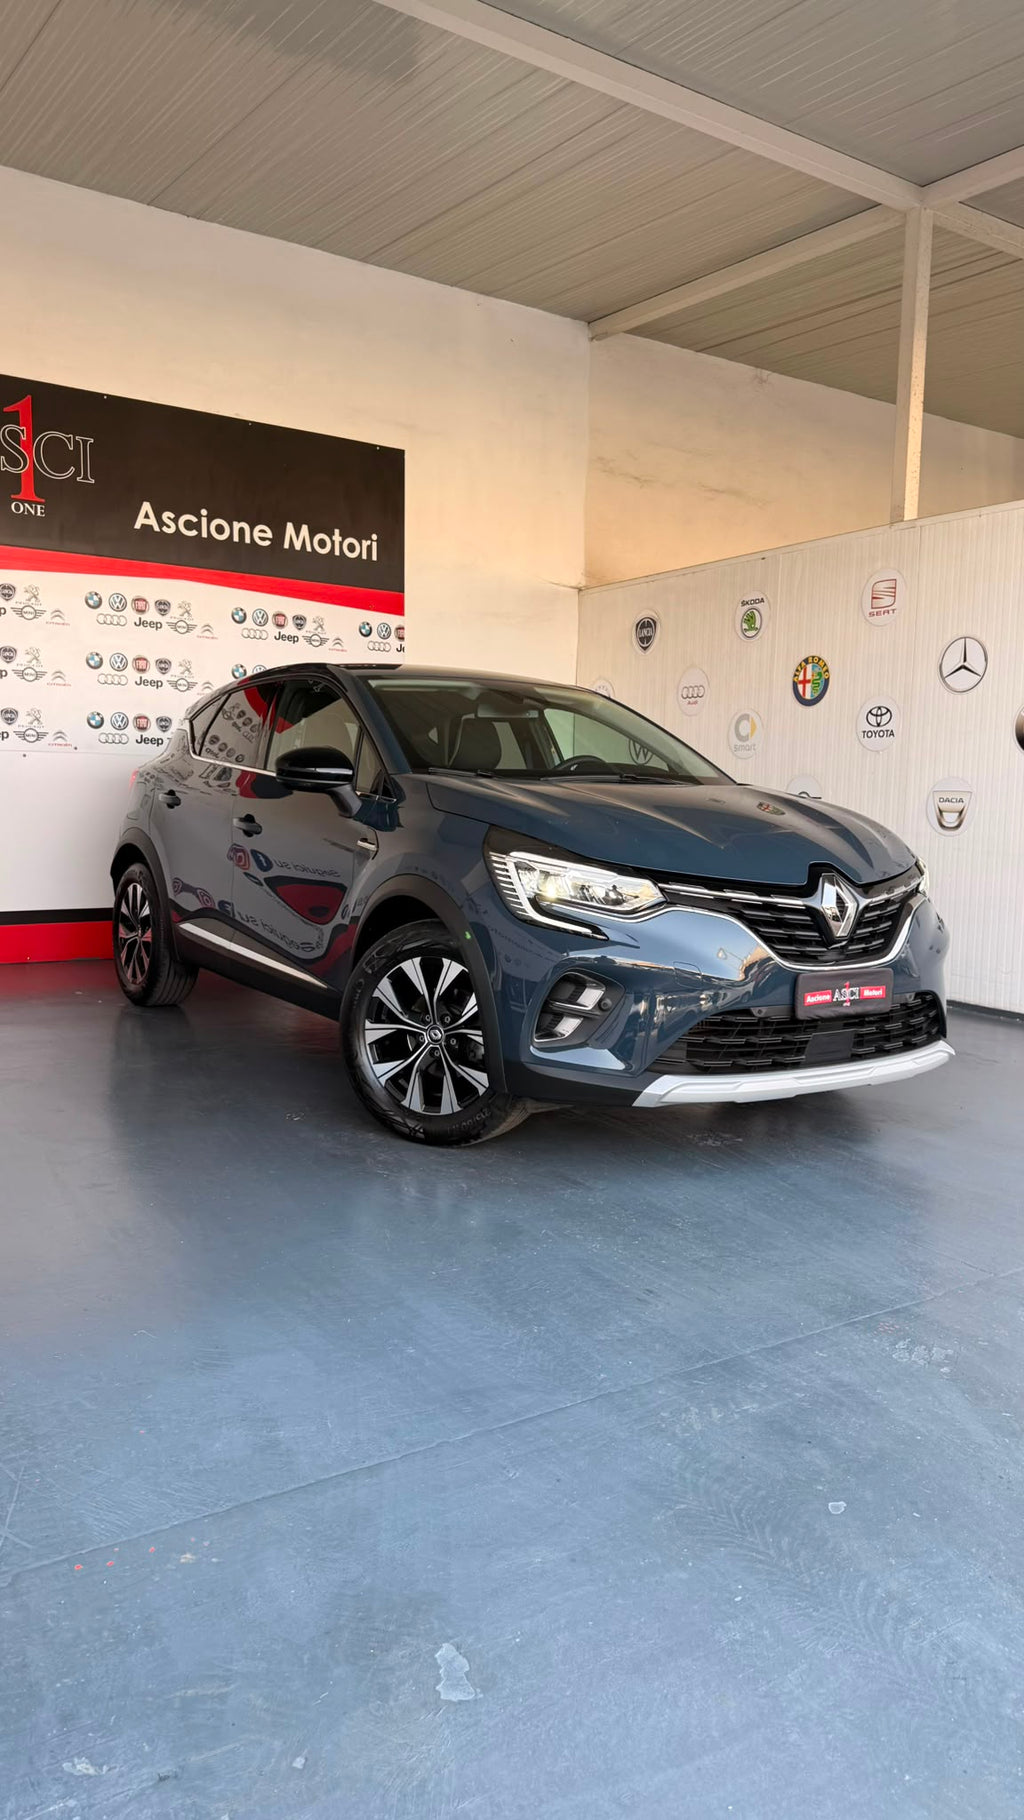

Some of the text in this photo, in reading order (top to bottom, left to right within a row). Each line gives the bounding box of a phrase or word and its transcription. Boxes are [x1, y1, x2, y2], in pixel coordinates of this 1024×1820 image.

[10, 502, 46, 517] ONE
[133, 501, 378, 561] Ascione Motori
[868, 608, 897, 618] SEAT
[134, 617, 163, 631] Jeep
[274, 631, 300, 644] Jeep
[135, 676, 163, 689] Jeep
[861, 728, 895, 739] TOYOTA
[136, 734, 164, 747] Jeep
[733, 742, 756, 752] smart
